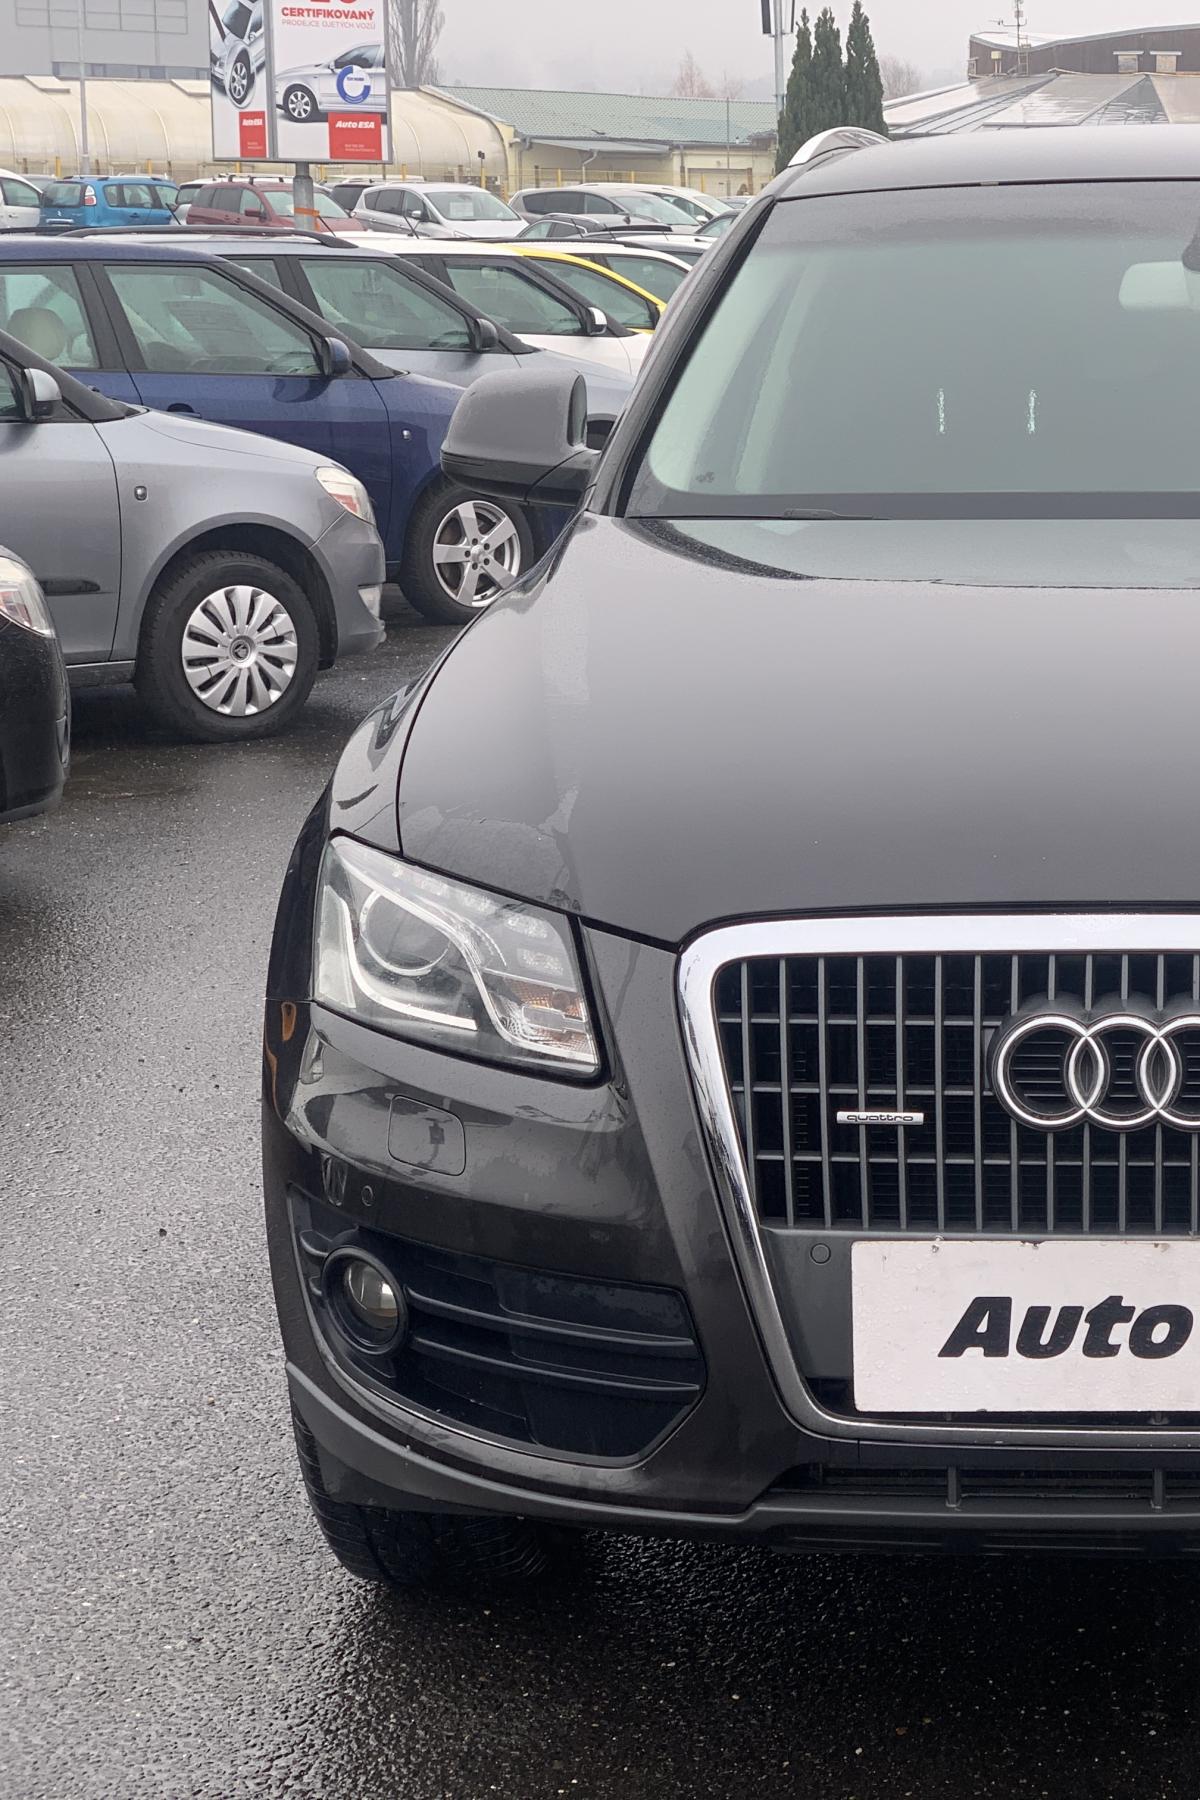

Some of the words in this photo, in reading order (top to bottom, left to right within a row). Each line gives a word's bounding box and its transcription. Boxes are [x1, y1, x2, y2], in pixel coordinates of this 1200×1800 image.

[281, 7, 375, 20] CERTIFIKOVANÝ
[335, 120, 357, 129] Auto
[358, 121, 376, 129] ESA
[846, 1114, 914, 1122] quattro
[938, 1295, 1193, 1359] Auto
